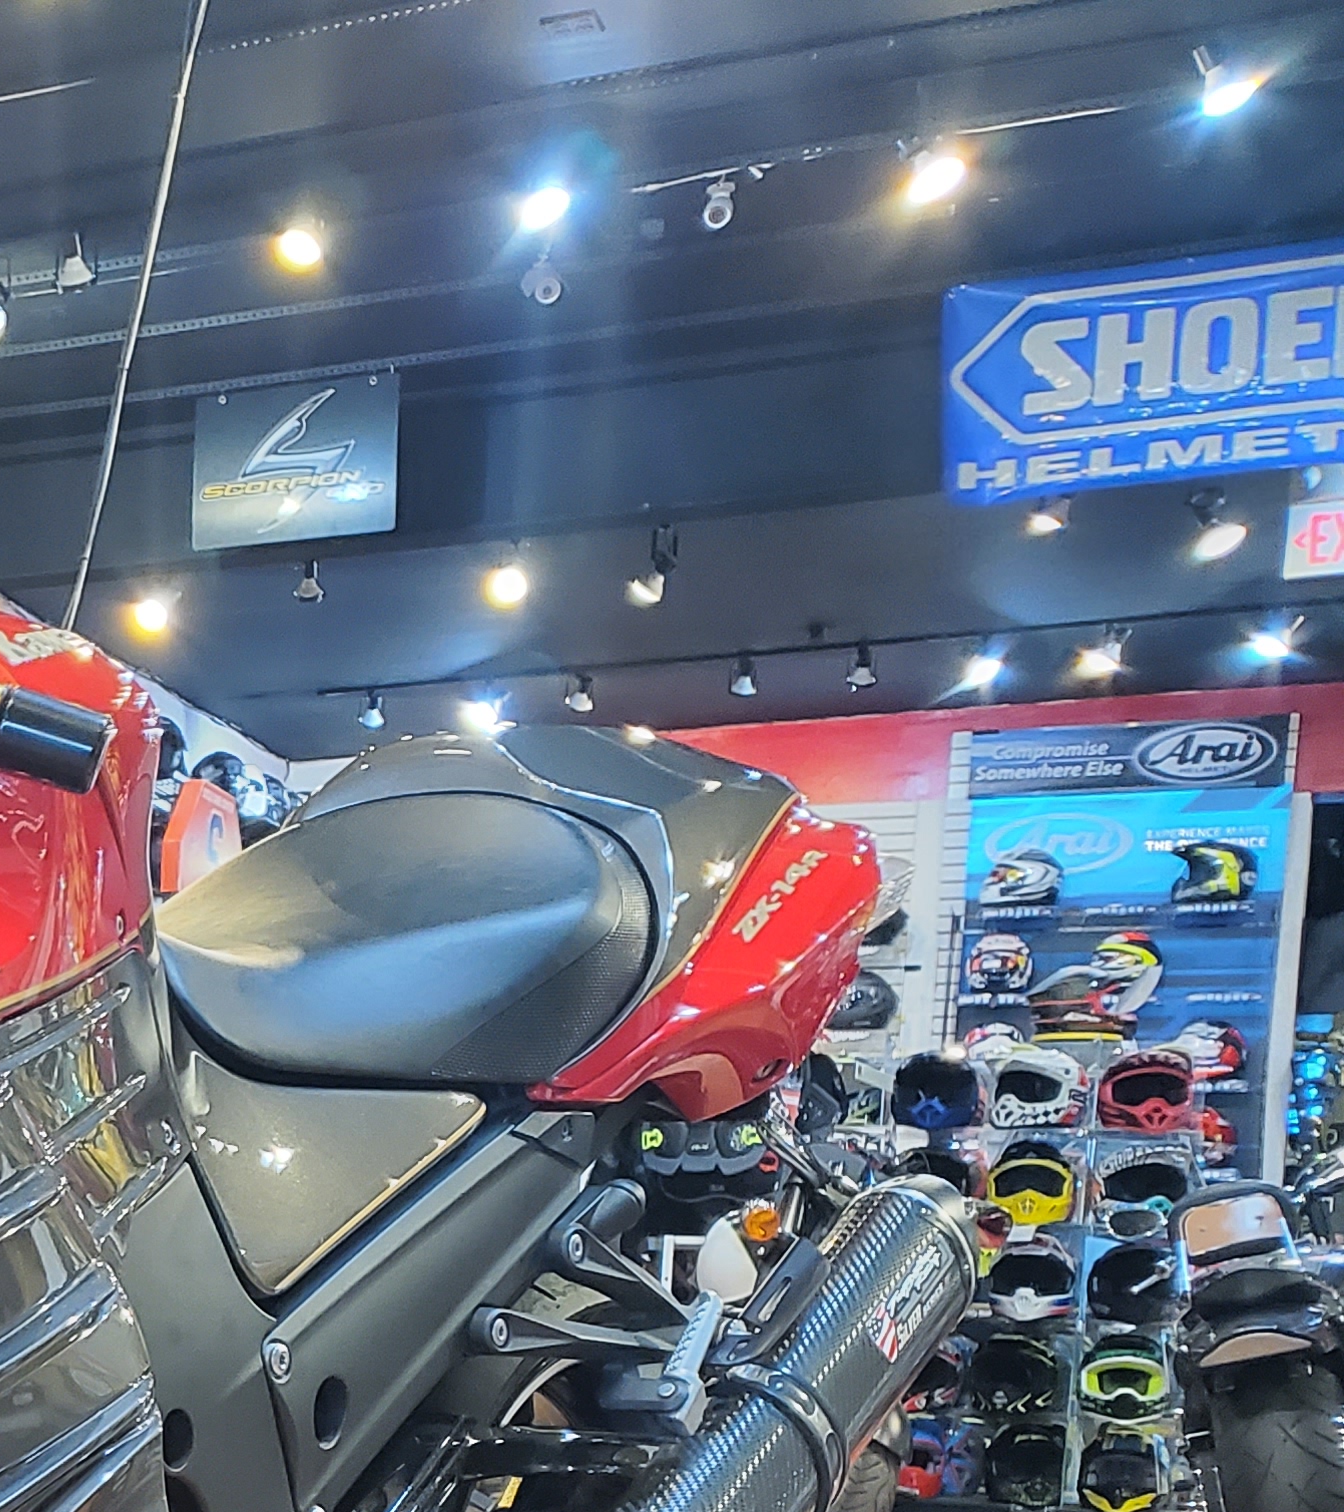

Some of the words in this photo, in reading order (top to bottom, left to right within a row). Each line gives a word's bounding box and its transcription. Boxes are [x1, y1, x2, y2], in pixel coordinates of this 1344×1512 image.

[200, 468, 362, 502] SCORPION
[991, 740, 1111, 763] Compromise
[1149, 733, 1258, 766] Arai
[974, 762, 1083, 782] Somewhere
[1085, 760, 1125, 777] Else
[1144, 840, 1173, 852] THE
[732, 849, 828, 942] ZX-14R
